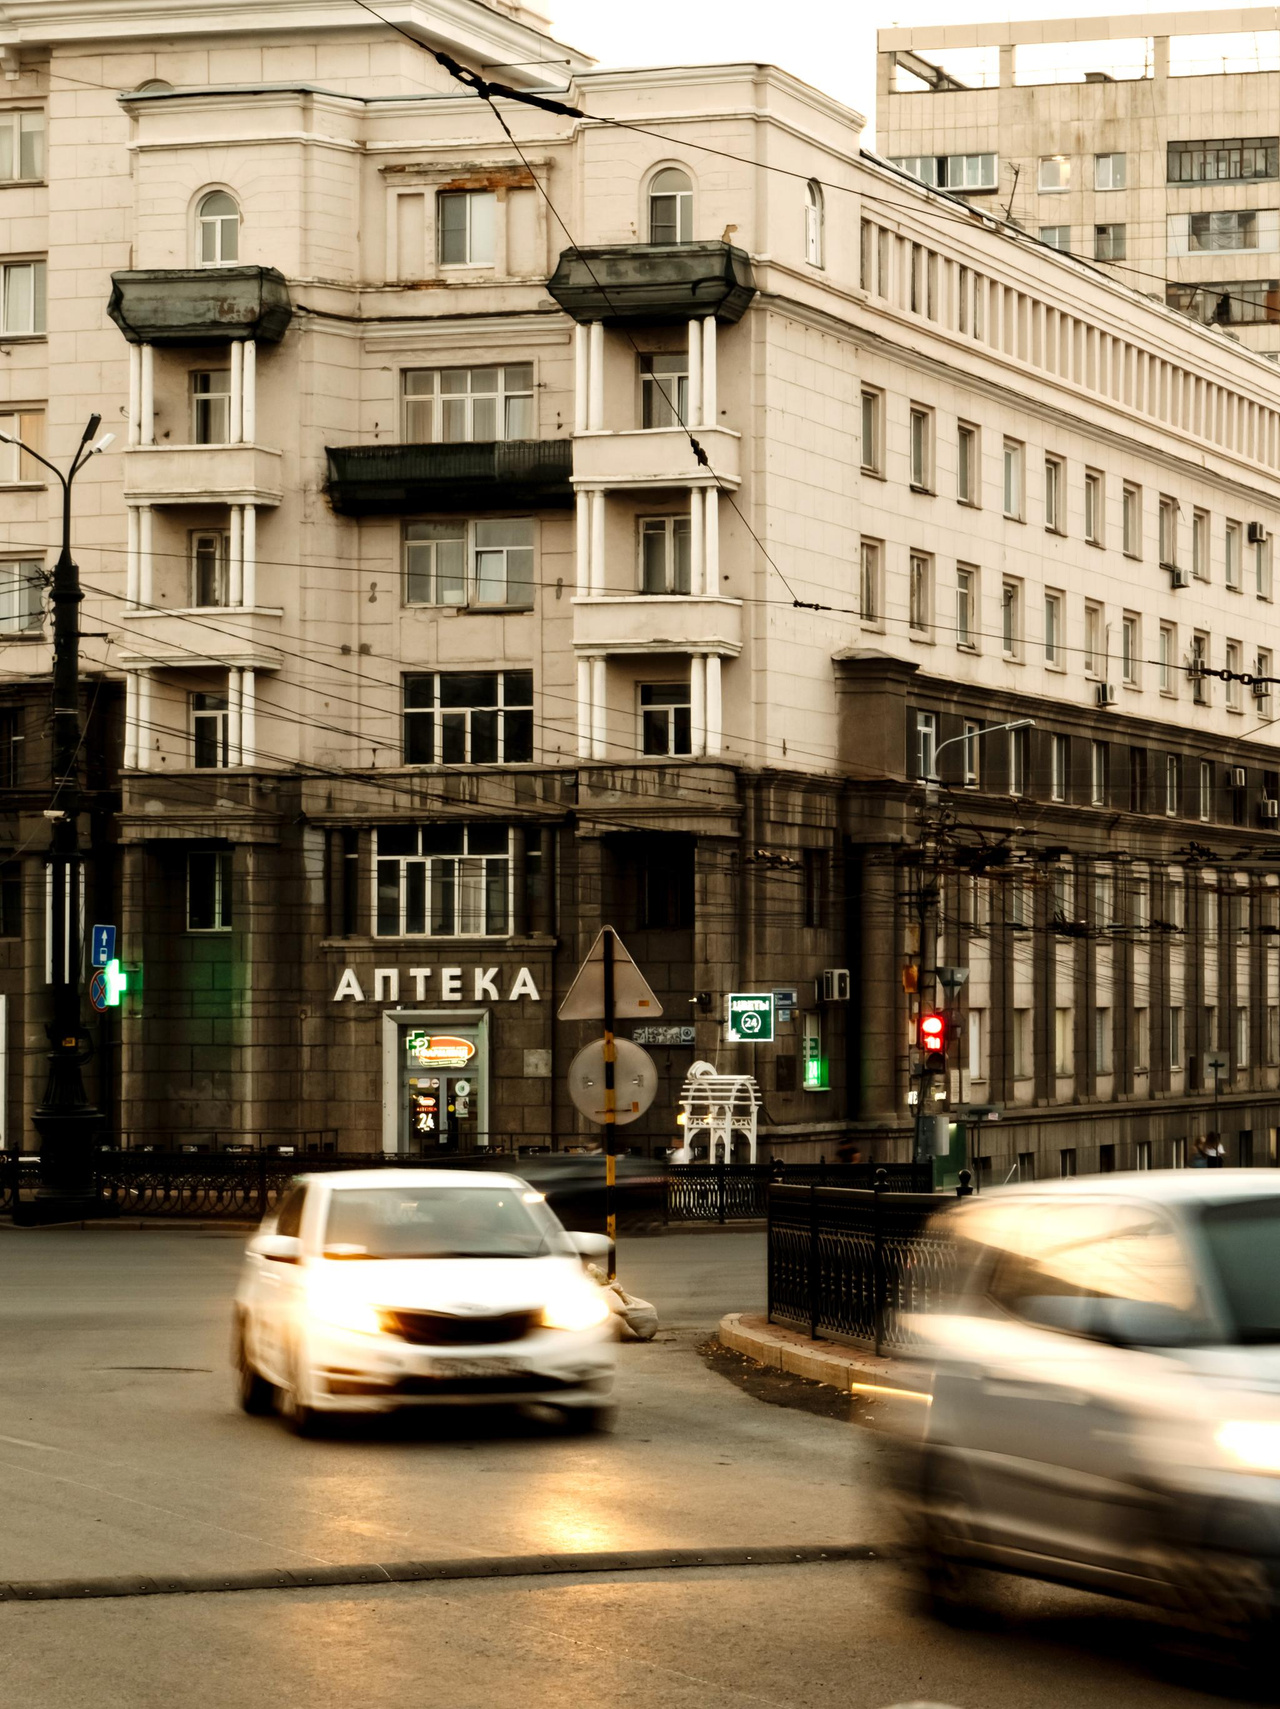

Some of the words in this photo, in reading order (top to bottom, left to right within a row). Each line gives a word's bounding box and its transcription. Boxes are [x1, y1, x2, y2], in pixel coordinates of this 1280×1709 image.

[333, 967, 541, 1001] АПТЕКА
[732, 1000, 770, 1012] ЦВЕТЫ
[744, 1018, 758, 1028] 24
[419, 1113, 434, 1128] 24
